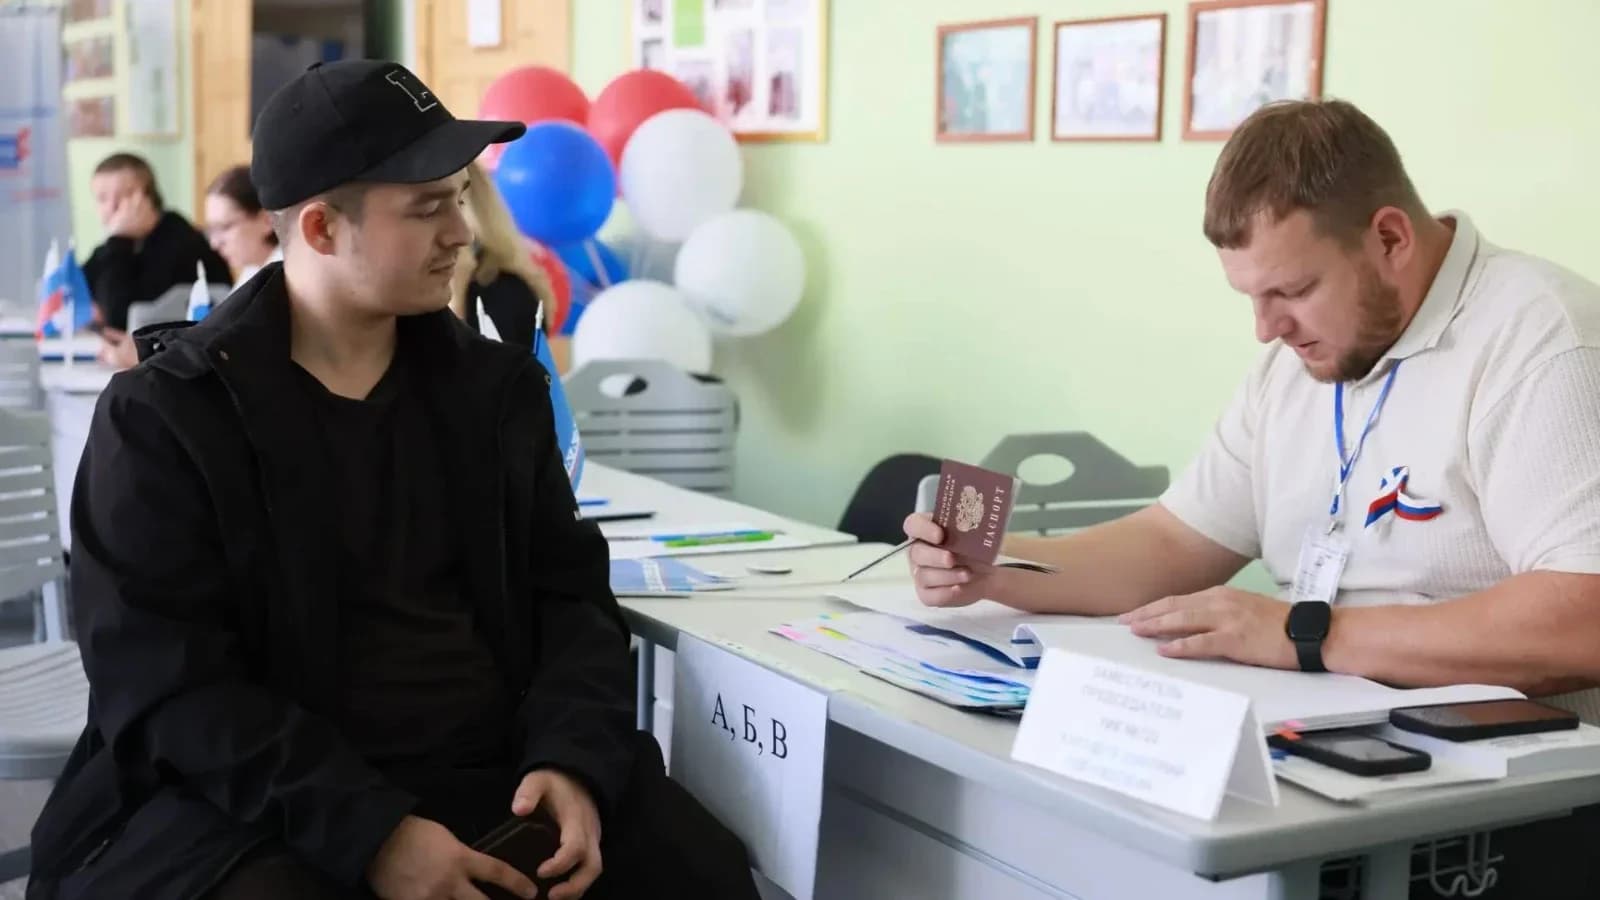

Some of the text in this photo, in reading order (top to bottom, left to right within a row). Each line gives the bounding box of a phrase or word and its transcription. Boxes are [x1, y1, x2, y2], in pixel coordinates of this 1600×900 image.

[983, 486, 1005, 548] ПАСПОРТ
[711, 692, 788, 759] А, Б, В
